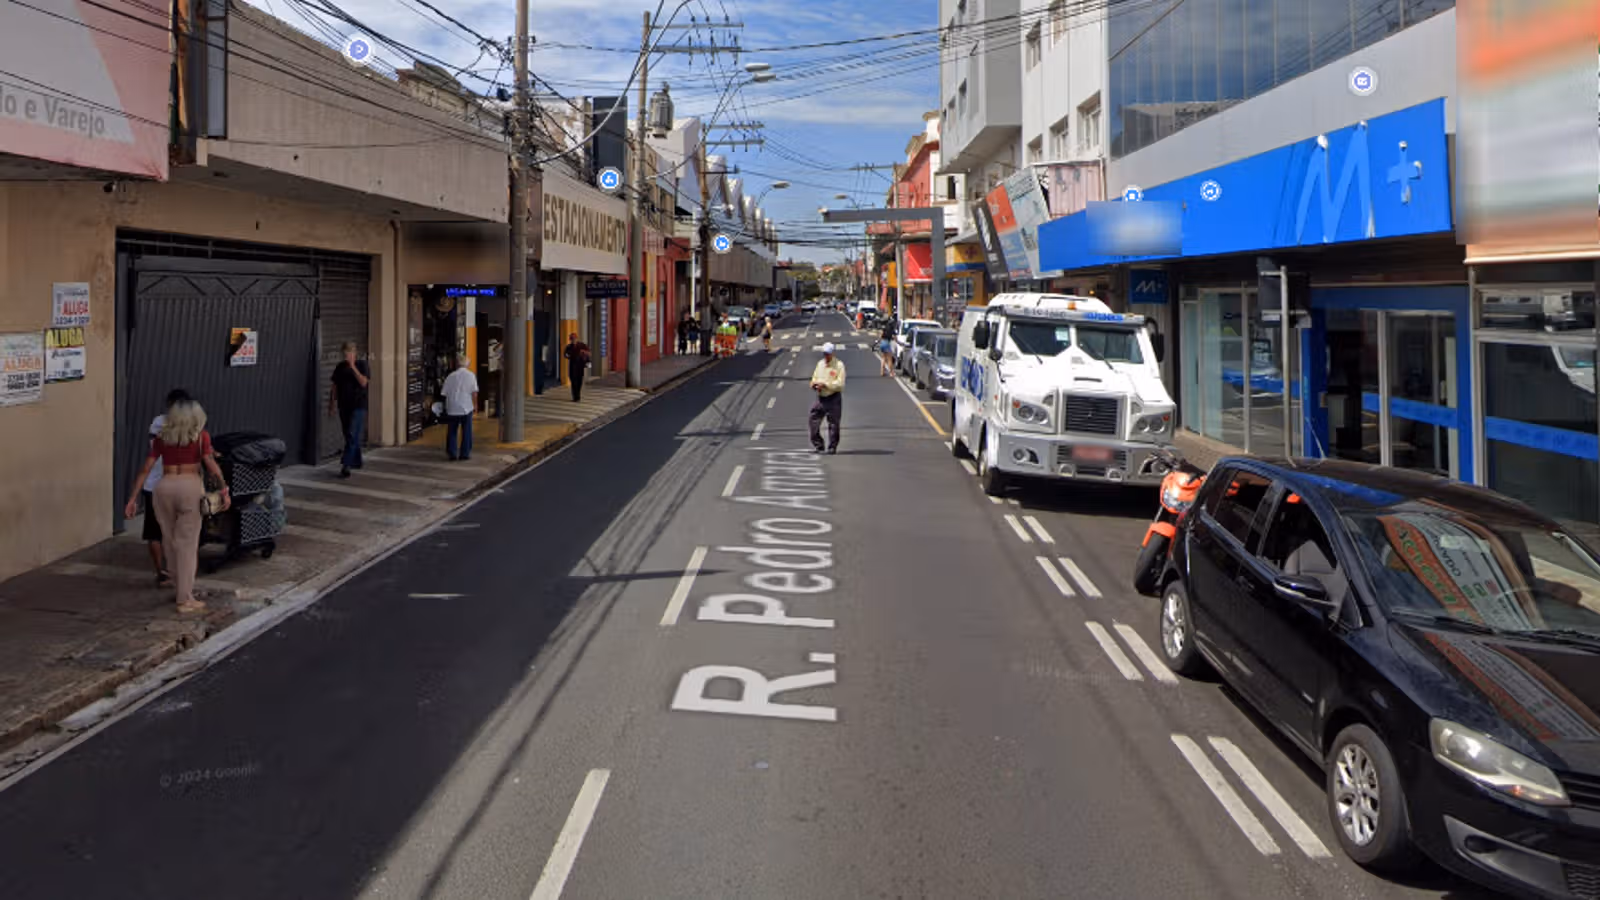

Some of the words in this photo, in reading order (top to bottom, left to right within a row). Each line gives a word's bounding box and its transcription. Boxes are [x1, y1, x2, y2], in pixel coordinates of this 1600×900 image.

[25, 98, 37, 119] e
[44, 97, 105, 138] Varejo
[543, 193, 626, 256] ESTACIONAMENTO
[62, 300, 89, 316] ALUGA
[46, 327, 84, 347] ALUGA
